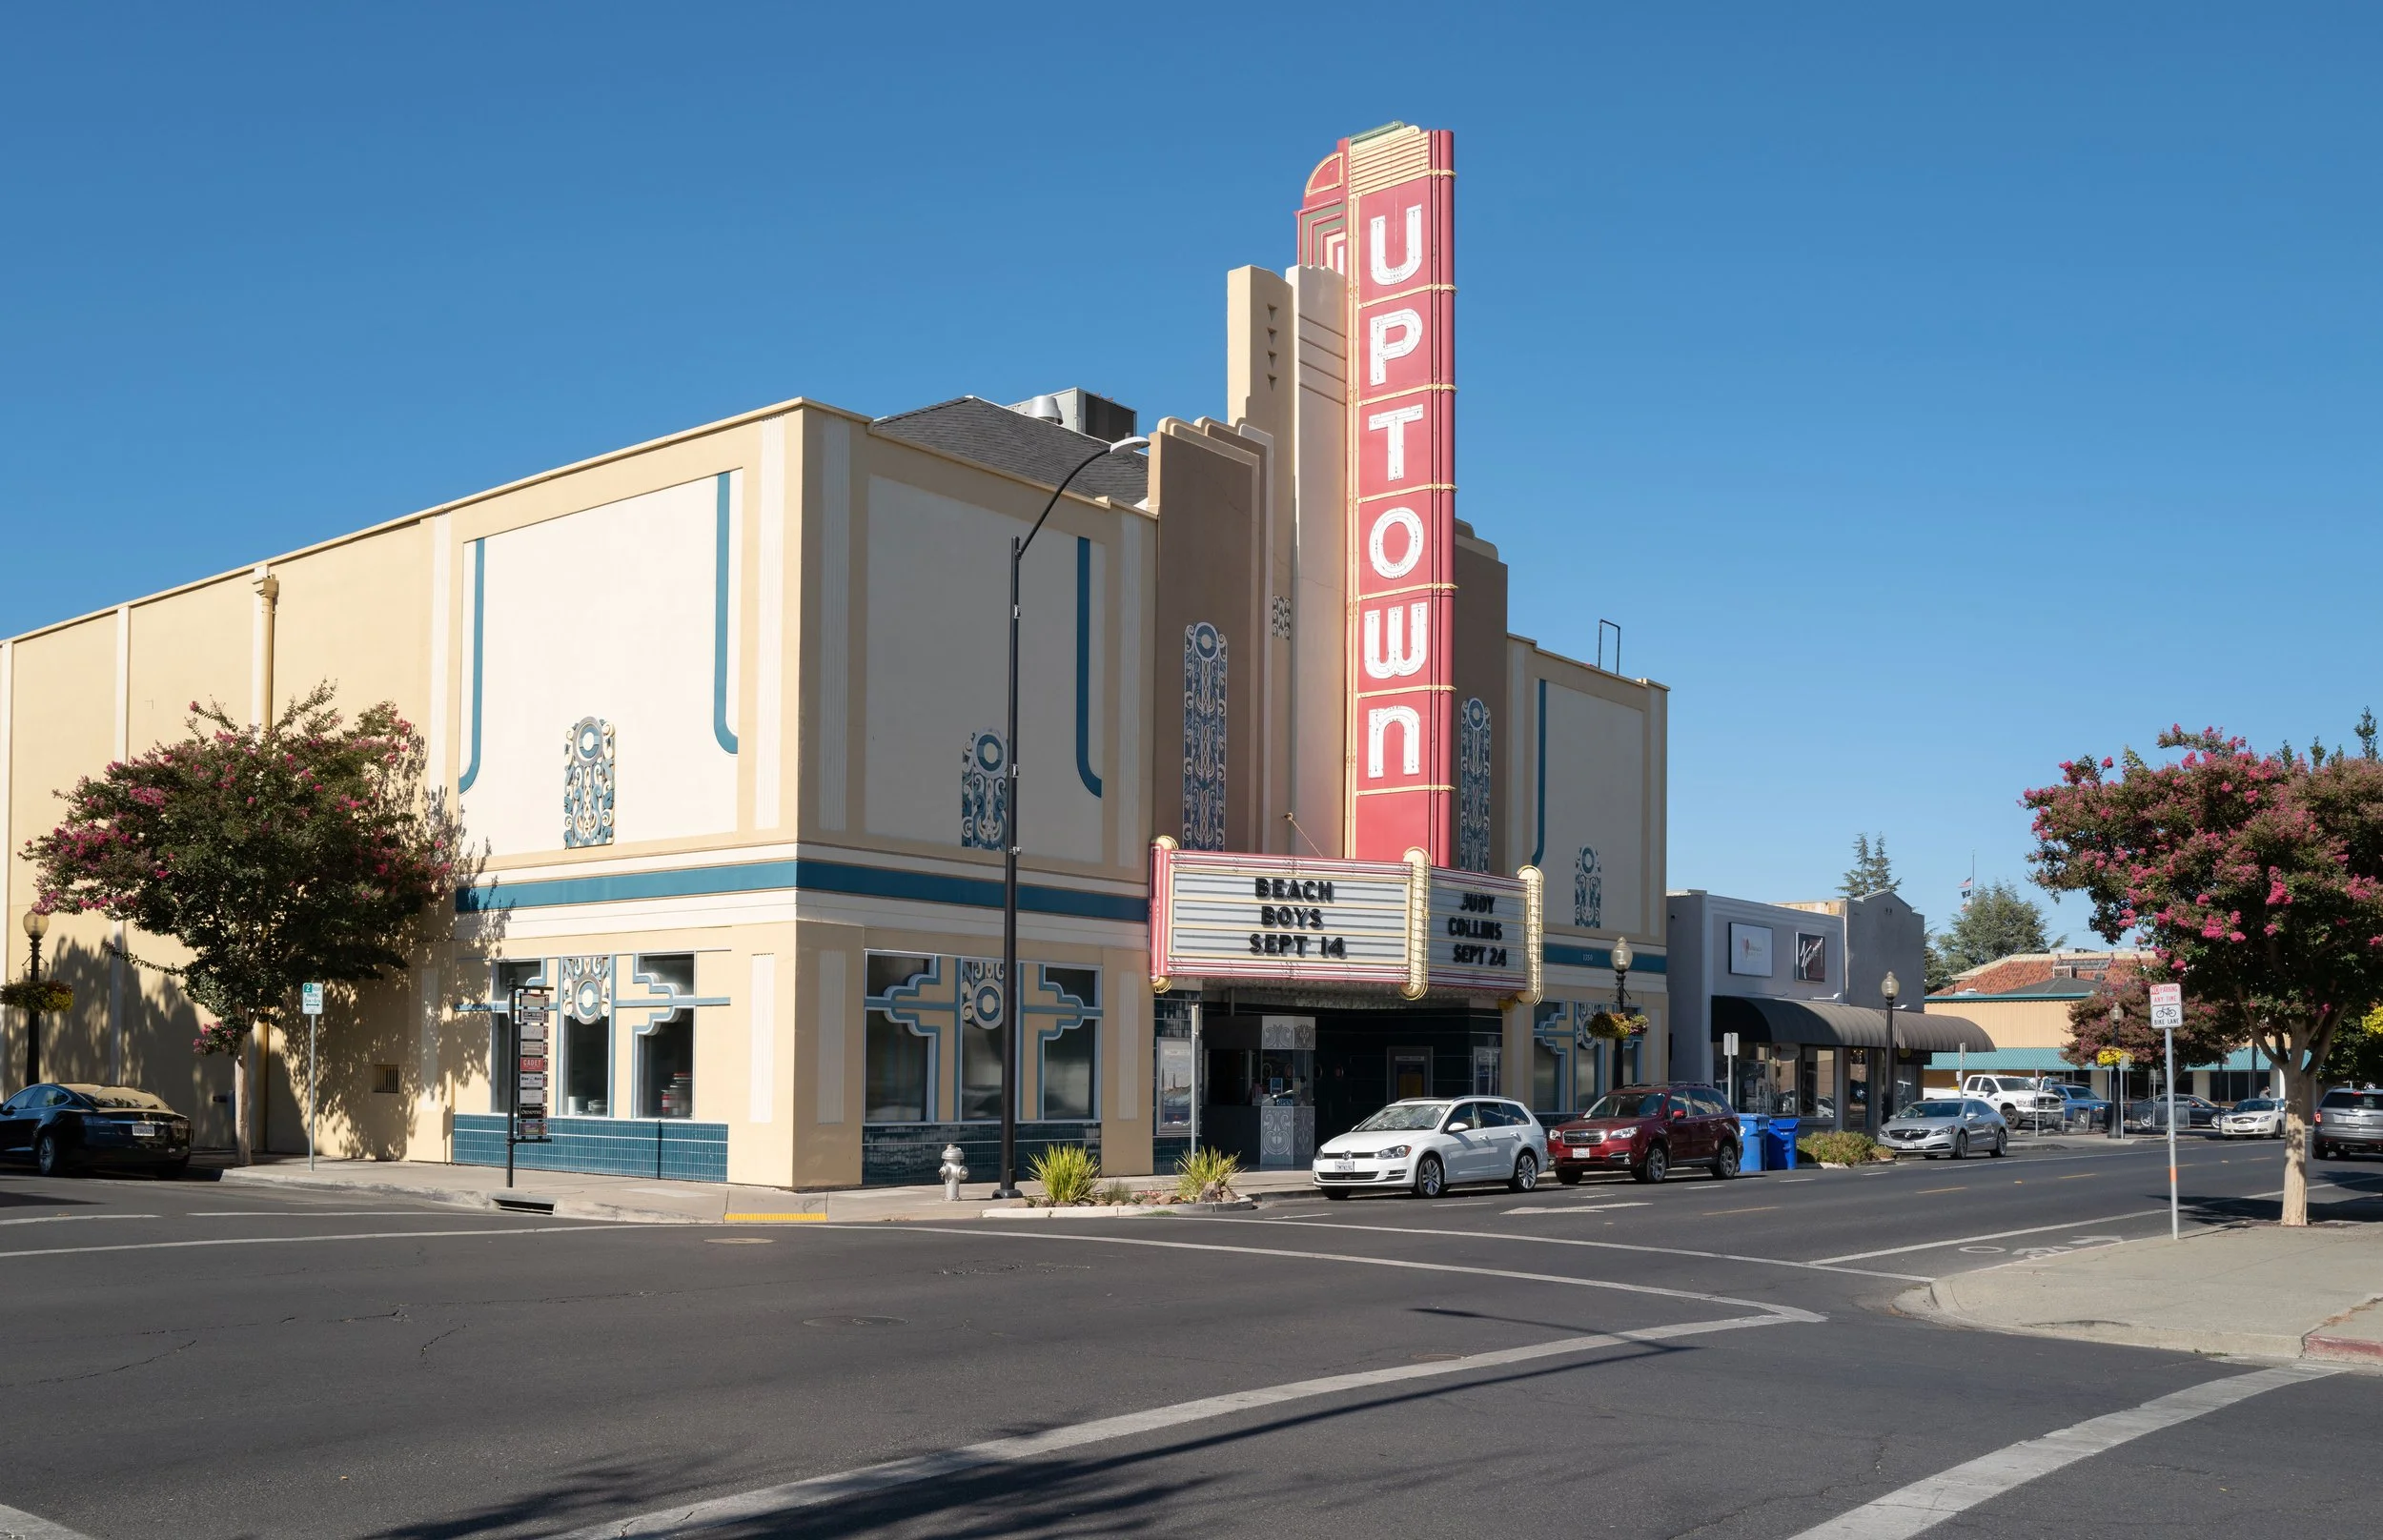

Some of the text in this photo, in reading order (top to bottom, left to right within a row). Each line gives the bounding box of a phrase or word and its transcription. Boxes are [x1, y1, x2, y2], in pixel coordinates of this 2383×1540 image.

[1363, 203, 1428, 780] UPTOWN
[1254, 878, 1333, 901] BEACH
[1459, 892, 1496, 915] JUDY
[1261, 905, 1322, 927] BOYS
[1448, 917, 1503, 942] COLLINS
[1249, 933, 1344, 957] SEPT 14
[1453, 943, 1507, 967] SEPT 24
[2150, 984, 2178, 996] NO PARKING
